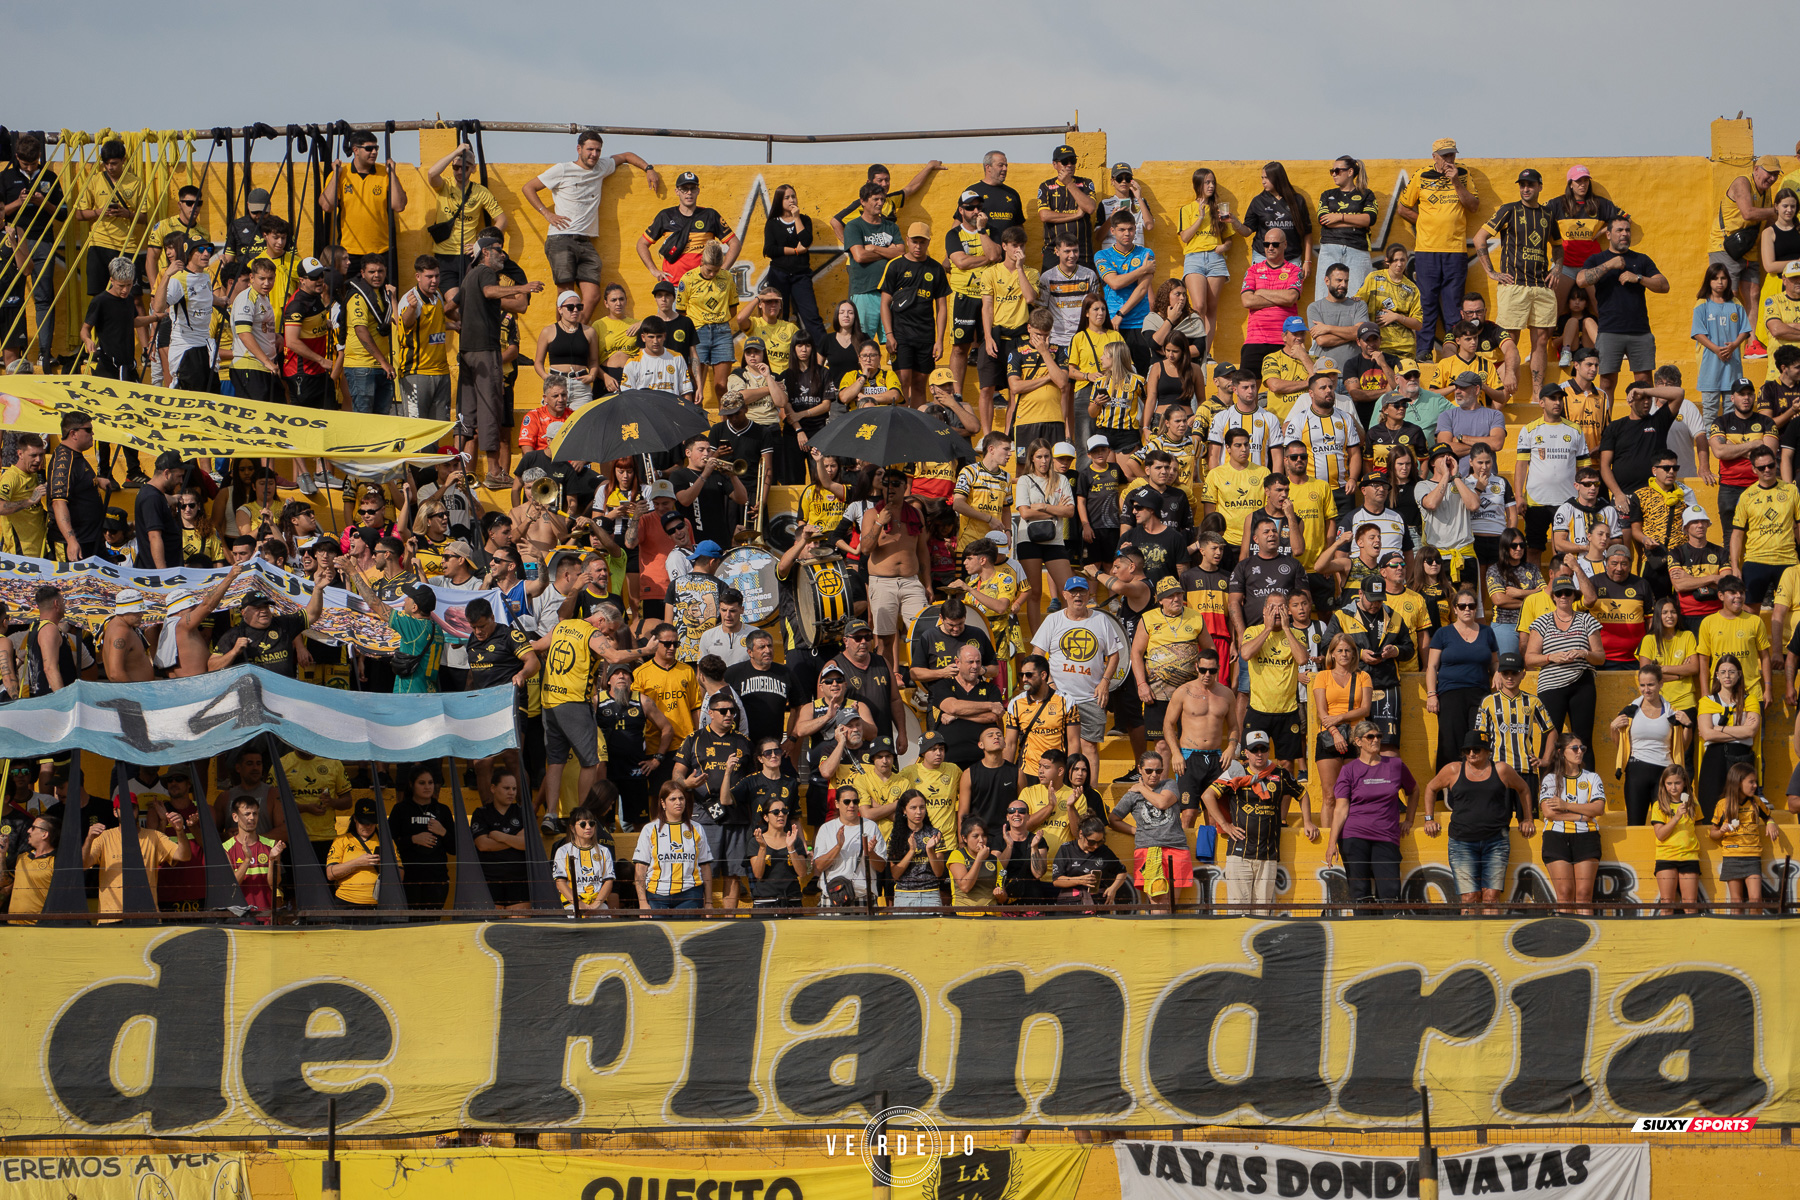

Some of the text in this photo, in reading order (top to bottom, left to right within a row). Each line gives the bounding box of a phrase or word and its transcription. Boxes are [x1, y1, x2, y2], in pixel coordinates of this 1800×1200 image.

[1719, 316, 1726, 326] 12
[768, 349, 790, 360] NARIO
[80, 381, 119, 398] LA
[127, 391, 257, 420] MUERTE
[263, 411, 328, 428] NOS
[115, 403, 135, 411] A
[143, 408, 288, 438] SEPARAR
[1312, 444, 1344, 453] CANARIO
[1225, 499, 1262, 507] CANARIO
[1597, 612, 1635, 620] CANARIO
[1063, 663, 1092, 676] LA 14
[873, 675, 887, 686] 14
[741, 676, 787, 698] LAUDERDALE
[657, 690, 686, 701] FIDEOS
[666, 701, 678, 712] 308
[96, 673, 283, 752] 14
[926, 798, 952, 806] NARIO
[411, 816, 430, 824] PUM
[1044, 820, 1067, 828] NARIO
[657, 853, 696, 861] CANARIO
[46, 917, 1770, 1131] de Flandria
[0, 1156, 122, 1183] EREMOS
[134, 1155, 156, 1175] A
[958, 1163, 989, 1183] LA
[1127, 1144, 1267, 1195] VAYAS
[1442, 1144, 1590, 1196] VAYAS
